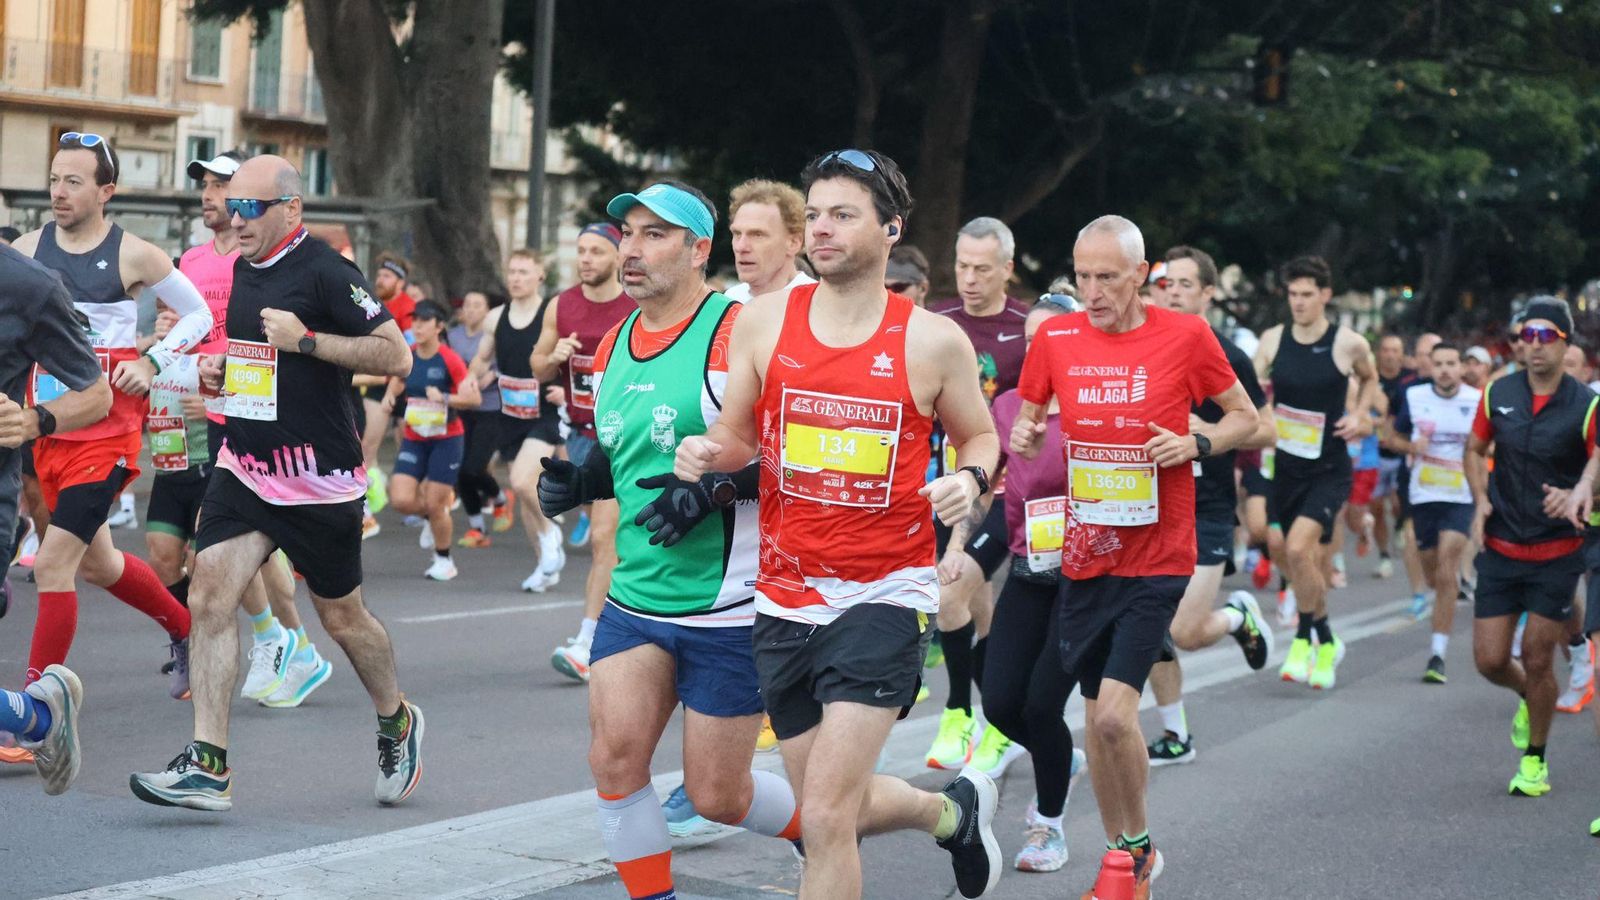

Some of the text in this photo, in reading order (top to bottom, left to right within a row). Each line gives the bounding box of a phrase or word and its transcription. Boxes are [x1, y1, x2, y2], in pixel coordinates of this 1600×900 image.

[236, 345, 272, 359] GENERALI
[1080, 366, 1129, 376] GENERALI
[1077, 385, 1128, 404] MÁLAGA
[813, 399, 892, 423] GENERALI
[818, 433, 858, 457] 134
[1089, 448, 1148, 462] GENERALI
[852, 480, 874, 490] 42K
[1085, 472, 1137, 490] 13620
[962, 809, 978, 846] saucony
